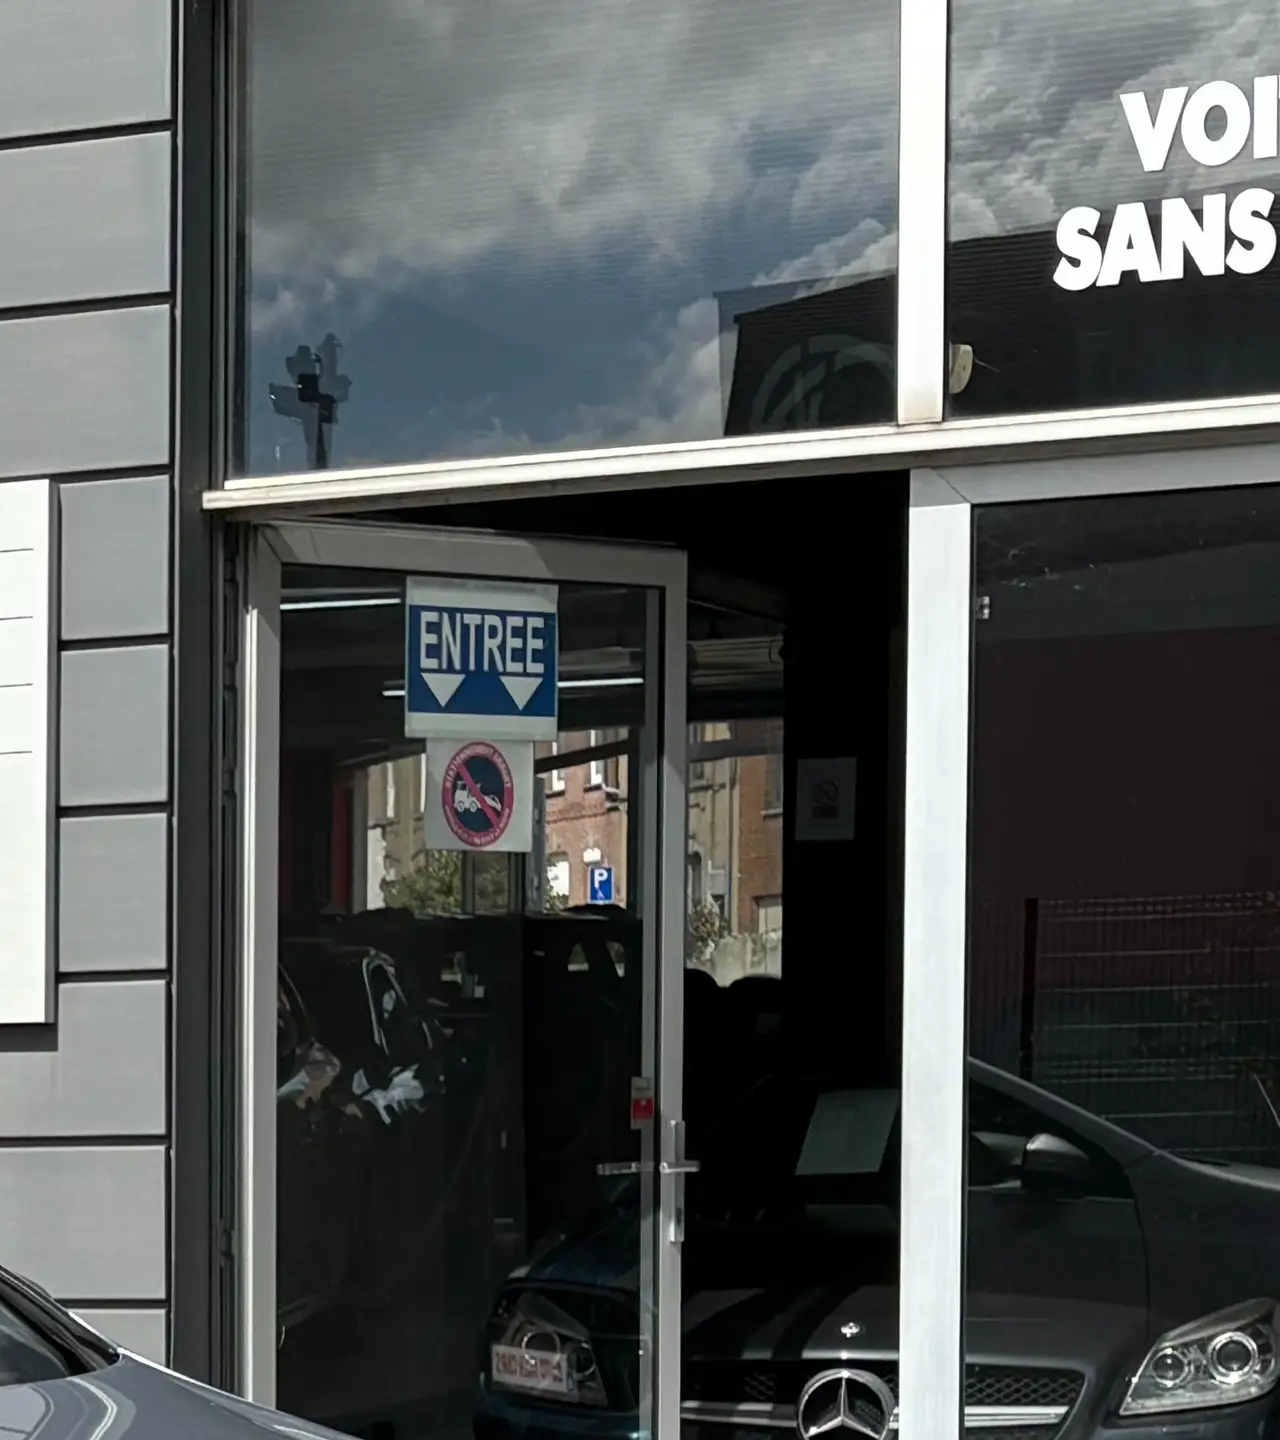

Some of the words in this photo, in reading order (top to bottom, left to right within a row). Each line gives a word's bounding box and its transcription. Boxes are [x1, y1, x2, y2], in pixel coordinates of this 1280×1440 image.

[1119, 75, 1280, 173] VOI
[1053, 188, 1277, 291] SANS
[419, 611, 545, 674] ENTREE
